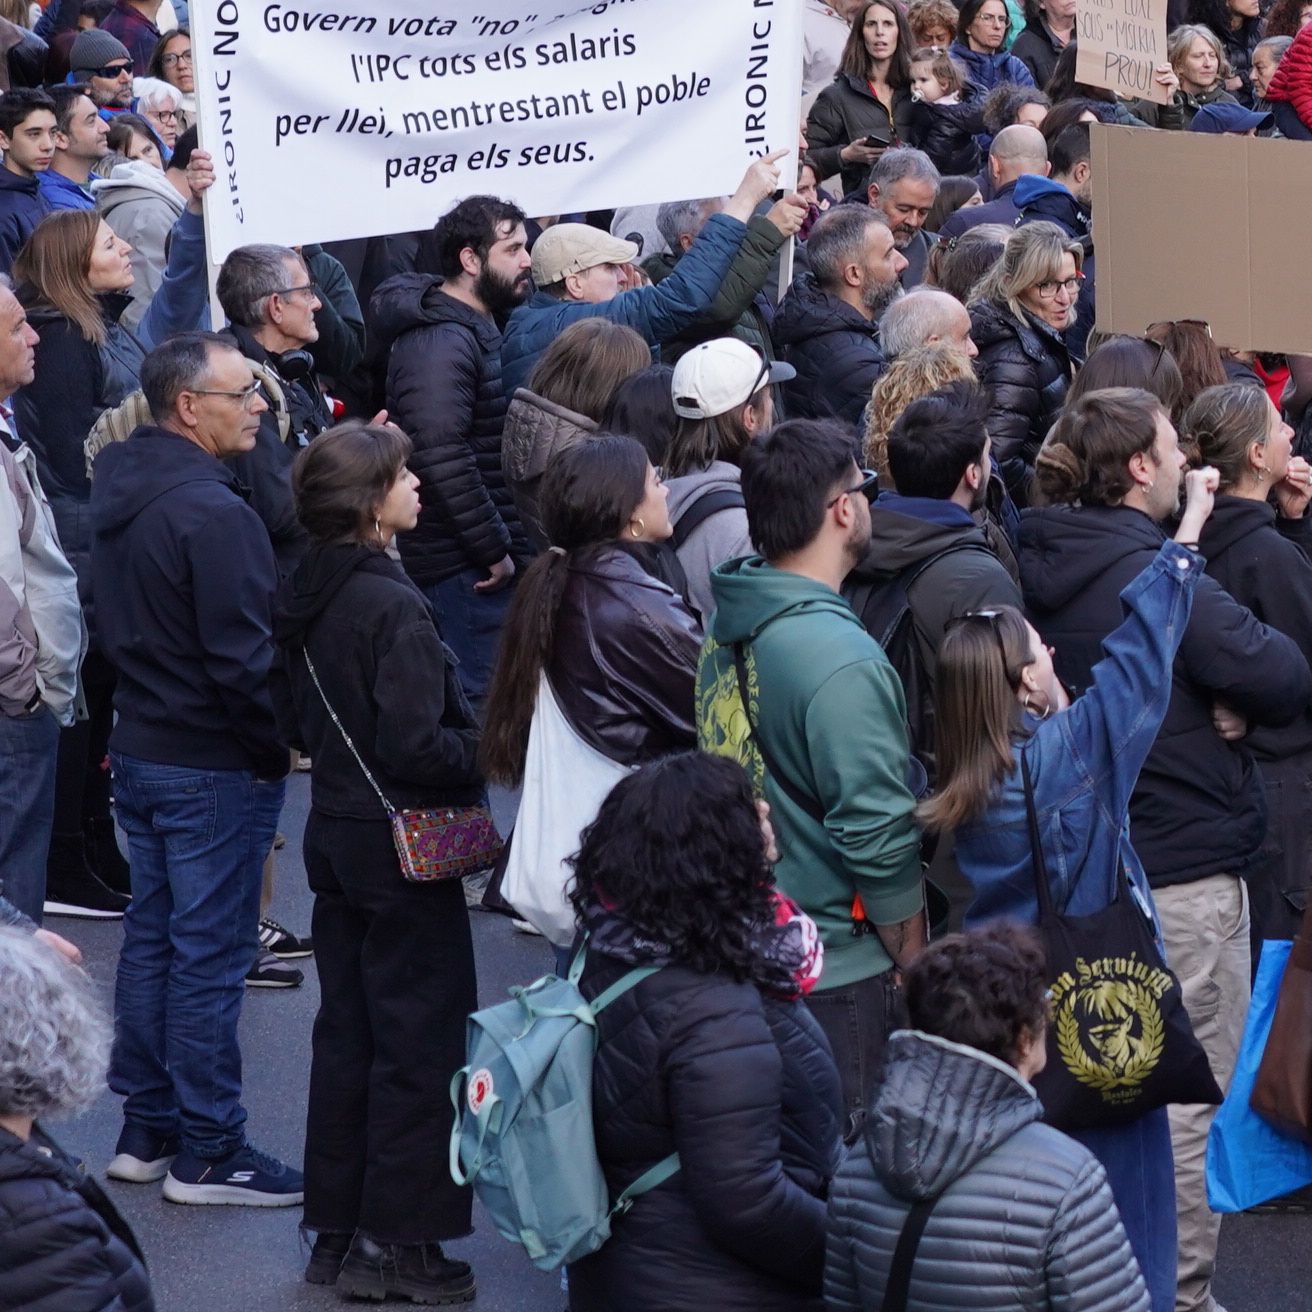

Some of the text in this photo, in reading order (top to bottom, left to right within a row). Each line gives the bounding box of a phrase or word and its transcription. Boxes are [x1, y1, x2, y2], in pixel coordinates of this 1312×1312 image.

[264, 4, 377, 34] Govern
[387, 15, 458, 37] vota
[351, 28, 637, 83] l'IPC tots els salaris
[1104, 51, 1154, 97] PROU!
[276, 72, 711, 147] per llei, mentrestant el poble
[385, 140, 595, 189] paga els seus.
